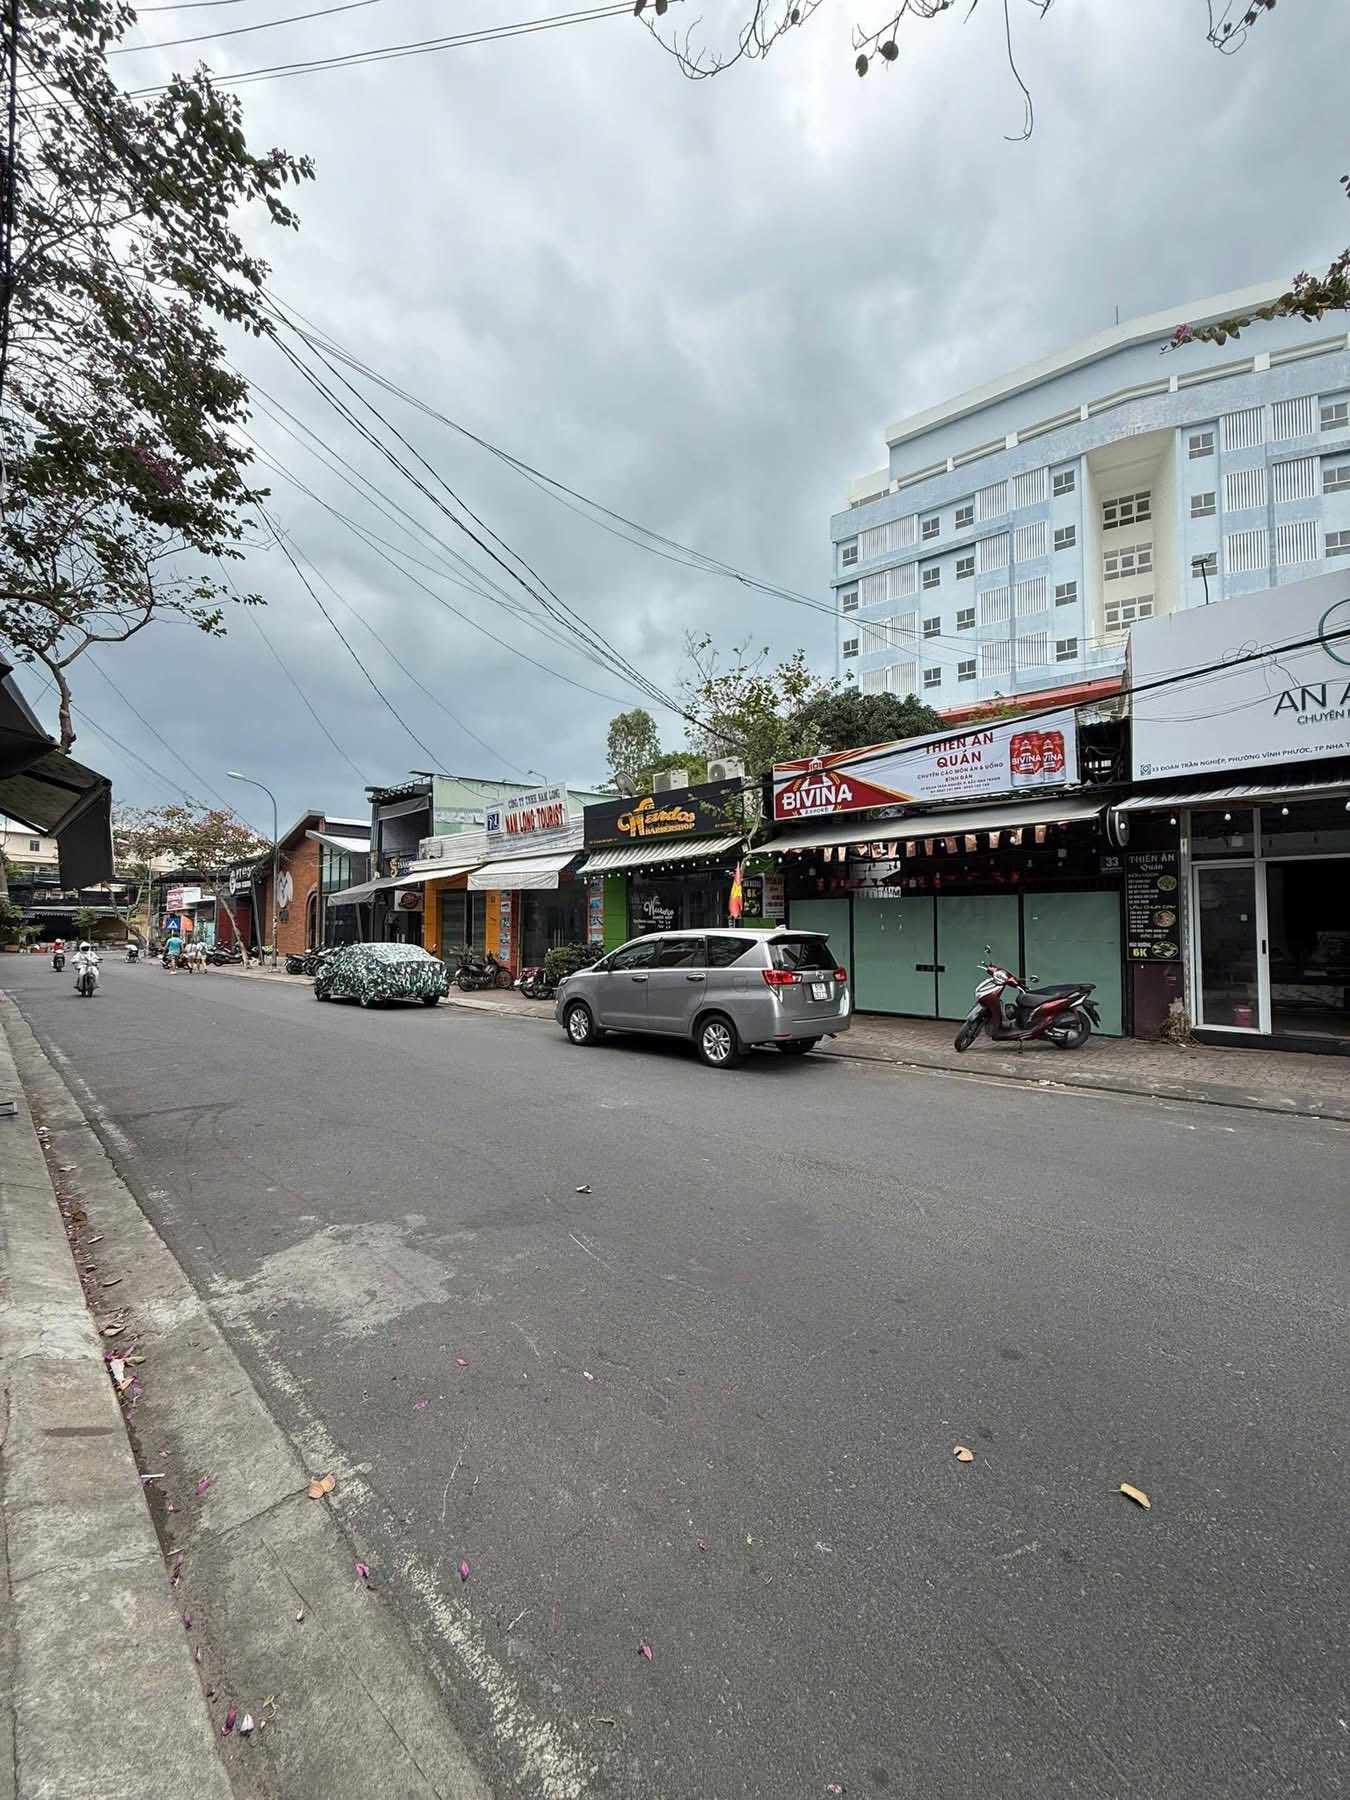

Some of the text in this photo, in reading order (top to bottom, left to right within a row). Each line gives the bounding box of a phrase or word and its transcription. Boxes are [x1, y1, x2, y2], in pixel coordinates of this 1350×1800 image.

[1273, 684, 1327, 715] AN
[1326, 743, 1344, 751] NHA
[936, 750, 982, 768] QUÁN
[782, 784, 852, 810] BIVINA
[1105, 857, 1119, 867] 33
[1133, 948, 1148, 957] 6K
